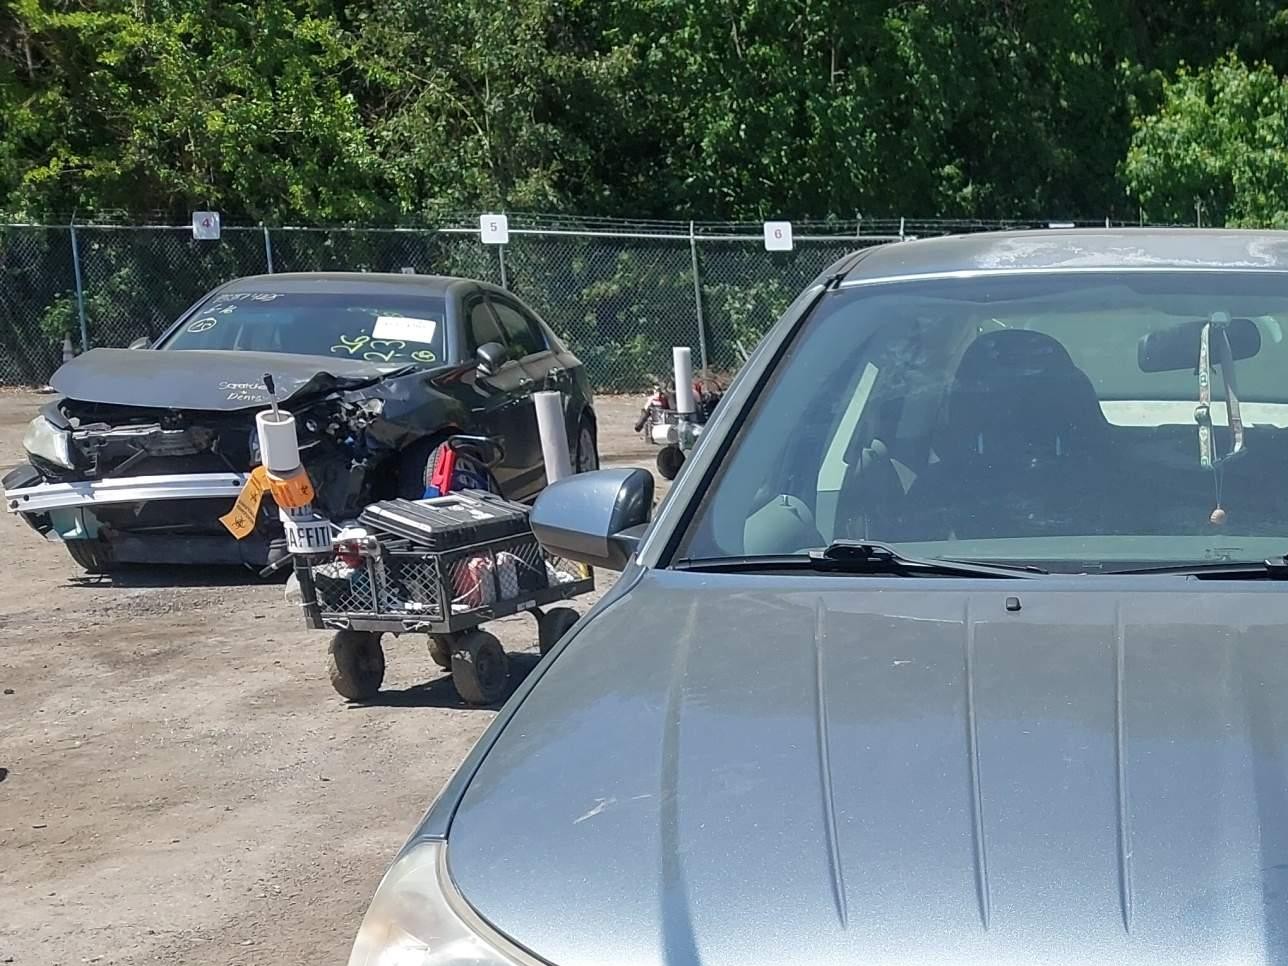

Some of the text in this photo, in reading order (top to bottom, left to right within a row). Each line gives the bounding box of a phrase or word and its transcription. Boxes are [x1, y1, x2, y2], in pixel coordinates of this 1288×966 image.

[202, 218, 210, 228] 4
[490, 222, 497, 232] 5
[774, 228, 782, 239] 6
